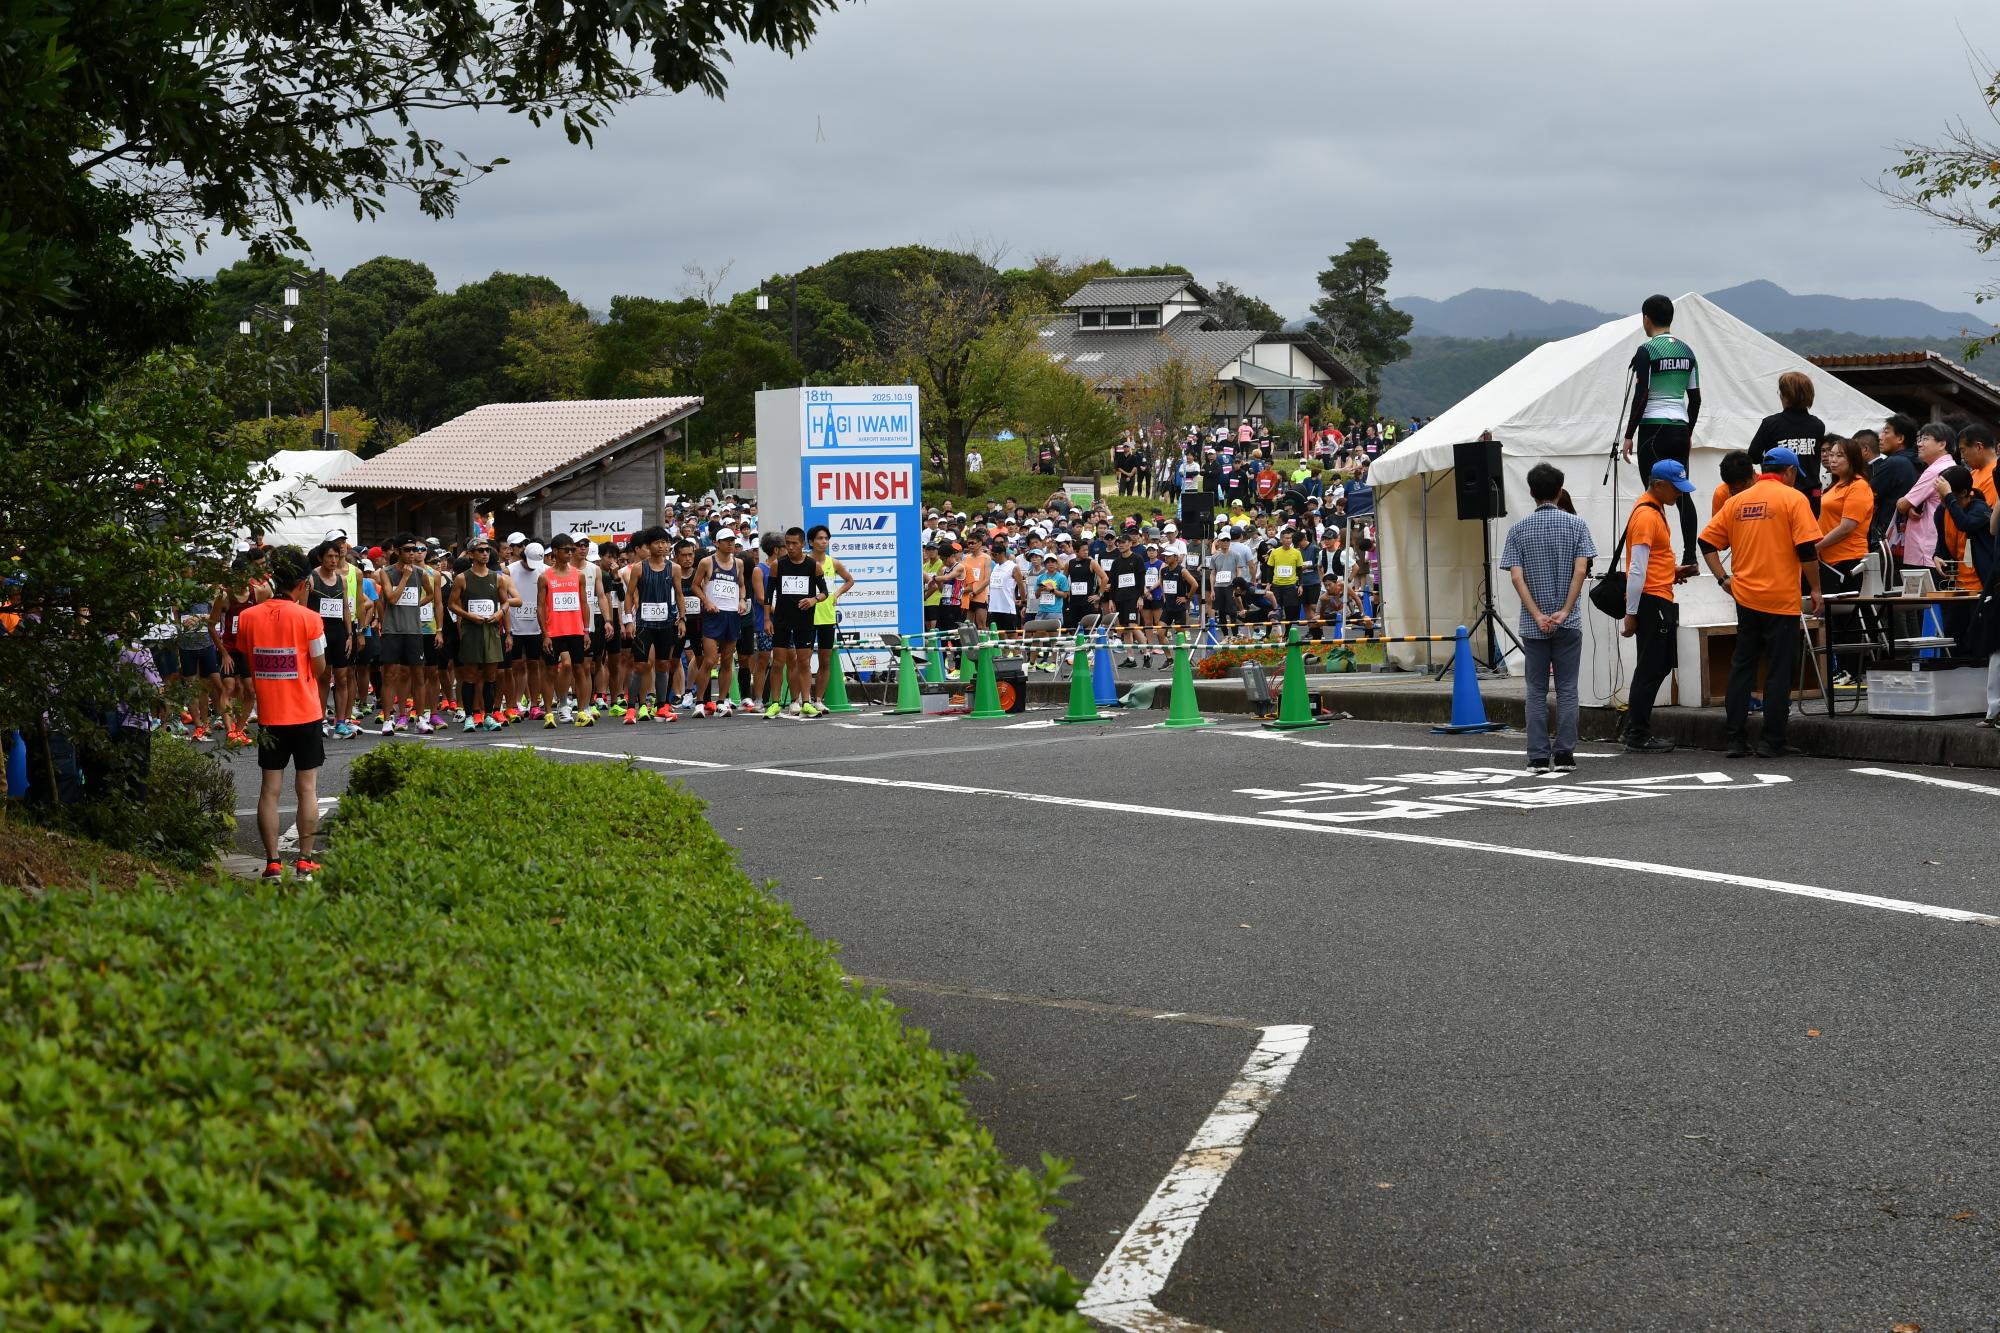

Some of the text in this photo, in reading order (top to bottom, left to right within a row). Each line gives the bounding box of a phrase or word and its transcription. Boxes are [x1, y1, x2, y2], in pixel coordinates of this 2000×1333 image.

[1659, 358, 1690, 371] IRELAND
[805, 390, 833, 402] 18th
[872, 393, 913, 402] 2025.10.19
[857, 415, 908, 433] IWAMI
[817, 471, 909, 501] FINISH
[1742, 505, 1764, 514] STAFF
[569, 520, 626, 533] スポーツくじ
[840, 517, 872, 531] ANA
[841, 541, 895, 551] 大畑建設株式会社
[714, 584, 720, 592] C
[782, 580, 804, 589] A 13
[562, 597, 577, 605] 901
[321, 602, 328, 611] C
[469, 604, 492, 613] E 509
[524, 606, 538, 615] 215
[643, 607, 666, 616] E 504
[1231, 767, 1573, 803] 徐行
[1257, 771, 1793, 822] 公園内
